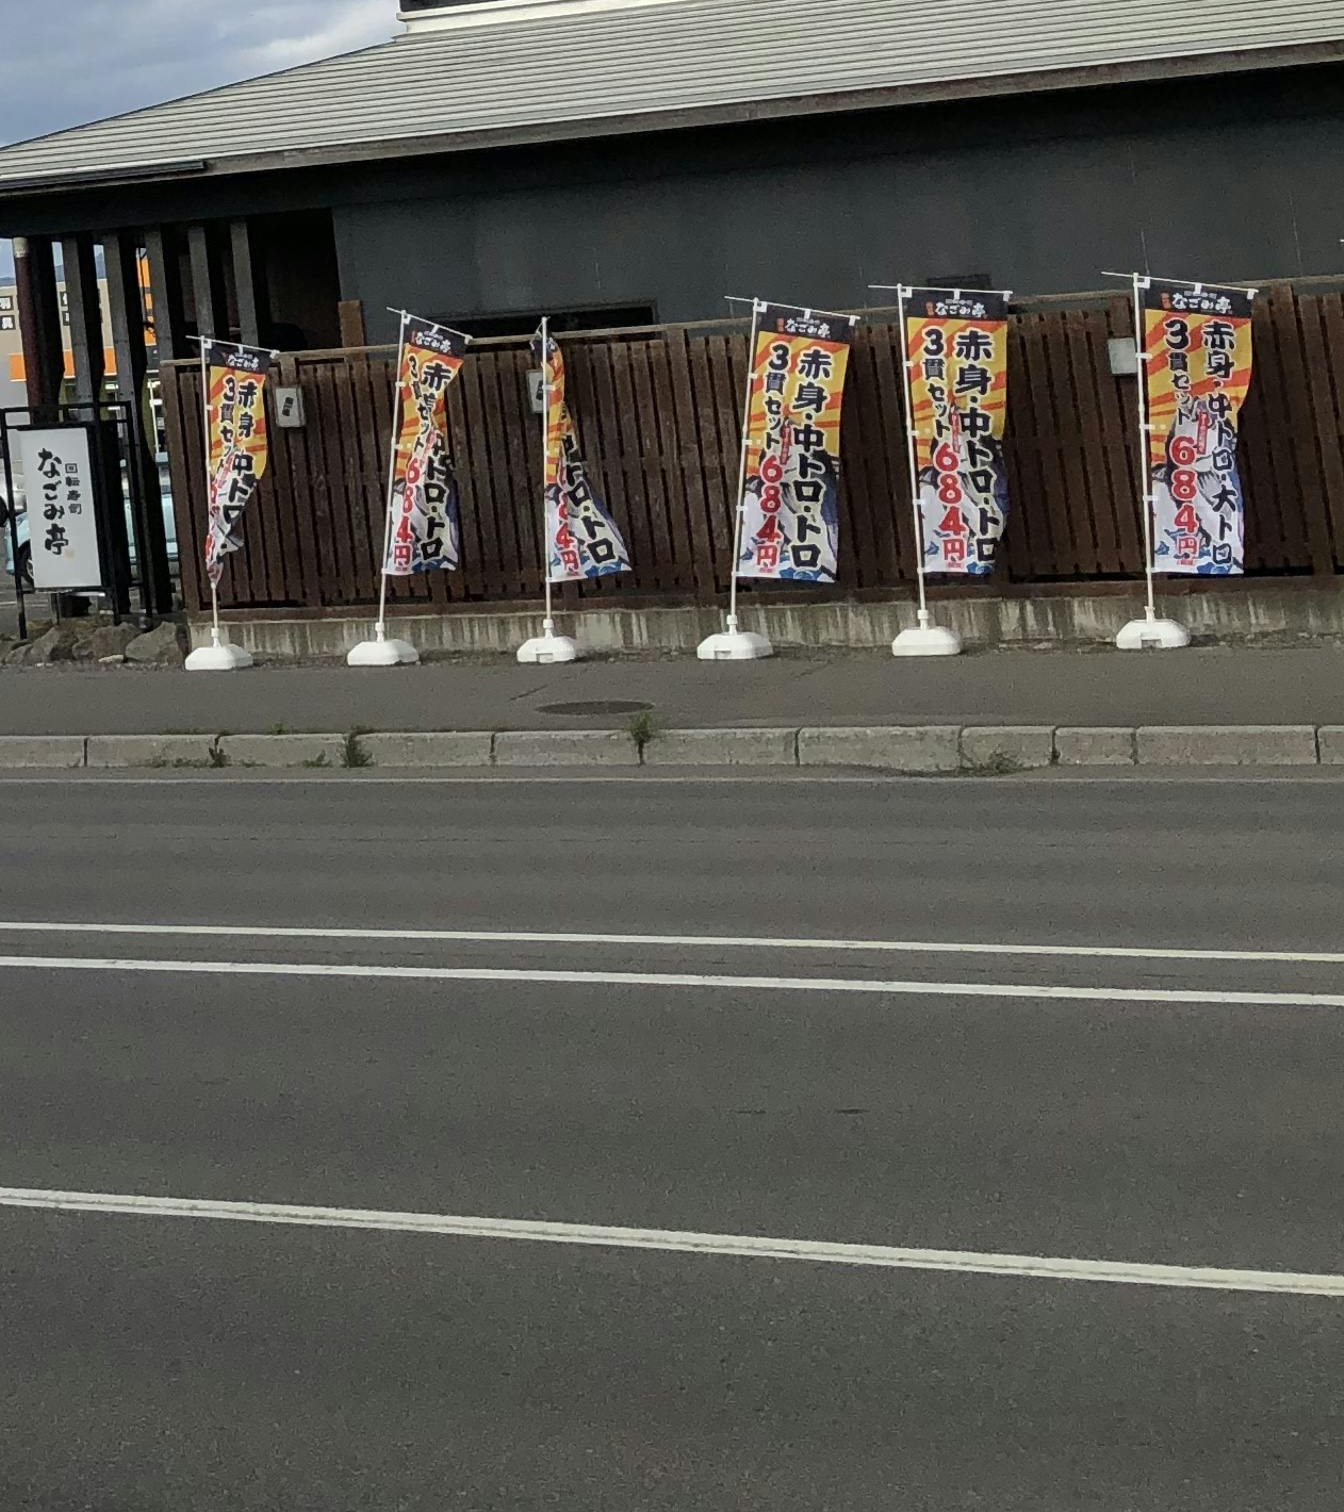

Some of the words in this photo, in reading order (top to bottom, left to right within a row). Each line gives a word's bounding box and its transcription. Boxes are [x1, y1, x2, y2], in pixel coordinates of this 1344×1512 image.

[784, 317, 831, 338] なごみ亭
[935, 301, 987, 318] なごみ亭
[1172, 292, 1232, 314] なごみ亭
[764, 343, 790, 450] 3貫セット
[923, 328, 951, 438] 3貫セット
[1164, 319, 1191, 426] 3貫セット
[37, 447, 69, 556] なごみ亭
[755, 454, 783, 567] 684円
[934, 441, 967, 561] 684円
[1169, 435, 1201, 557] 684円
